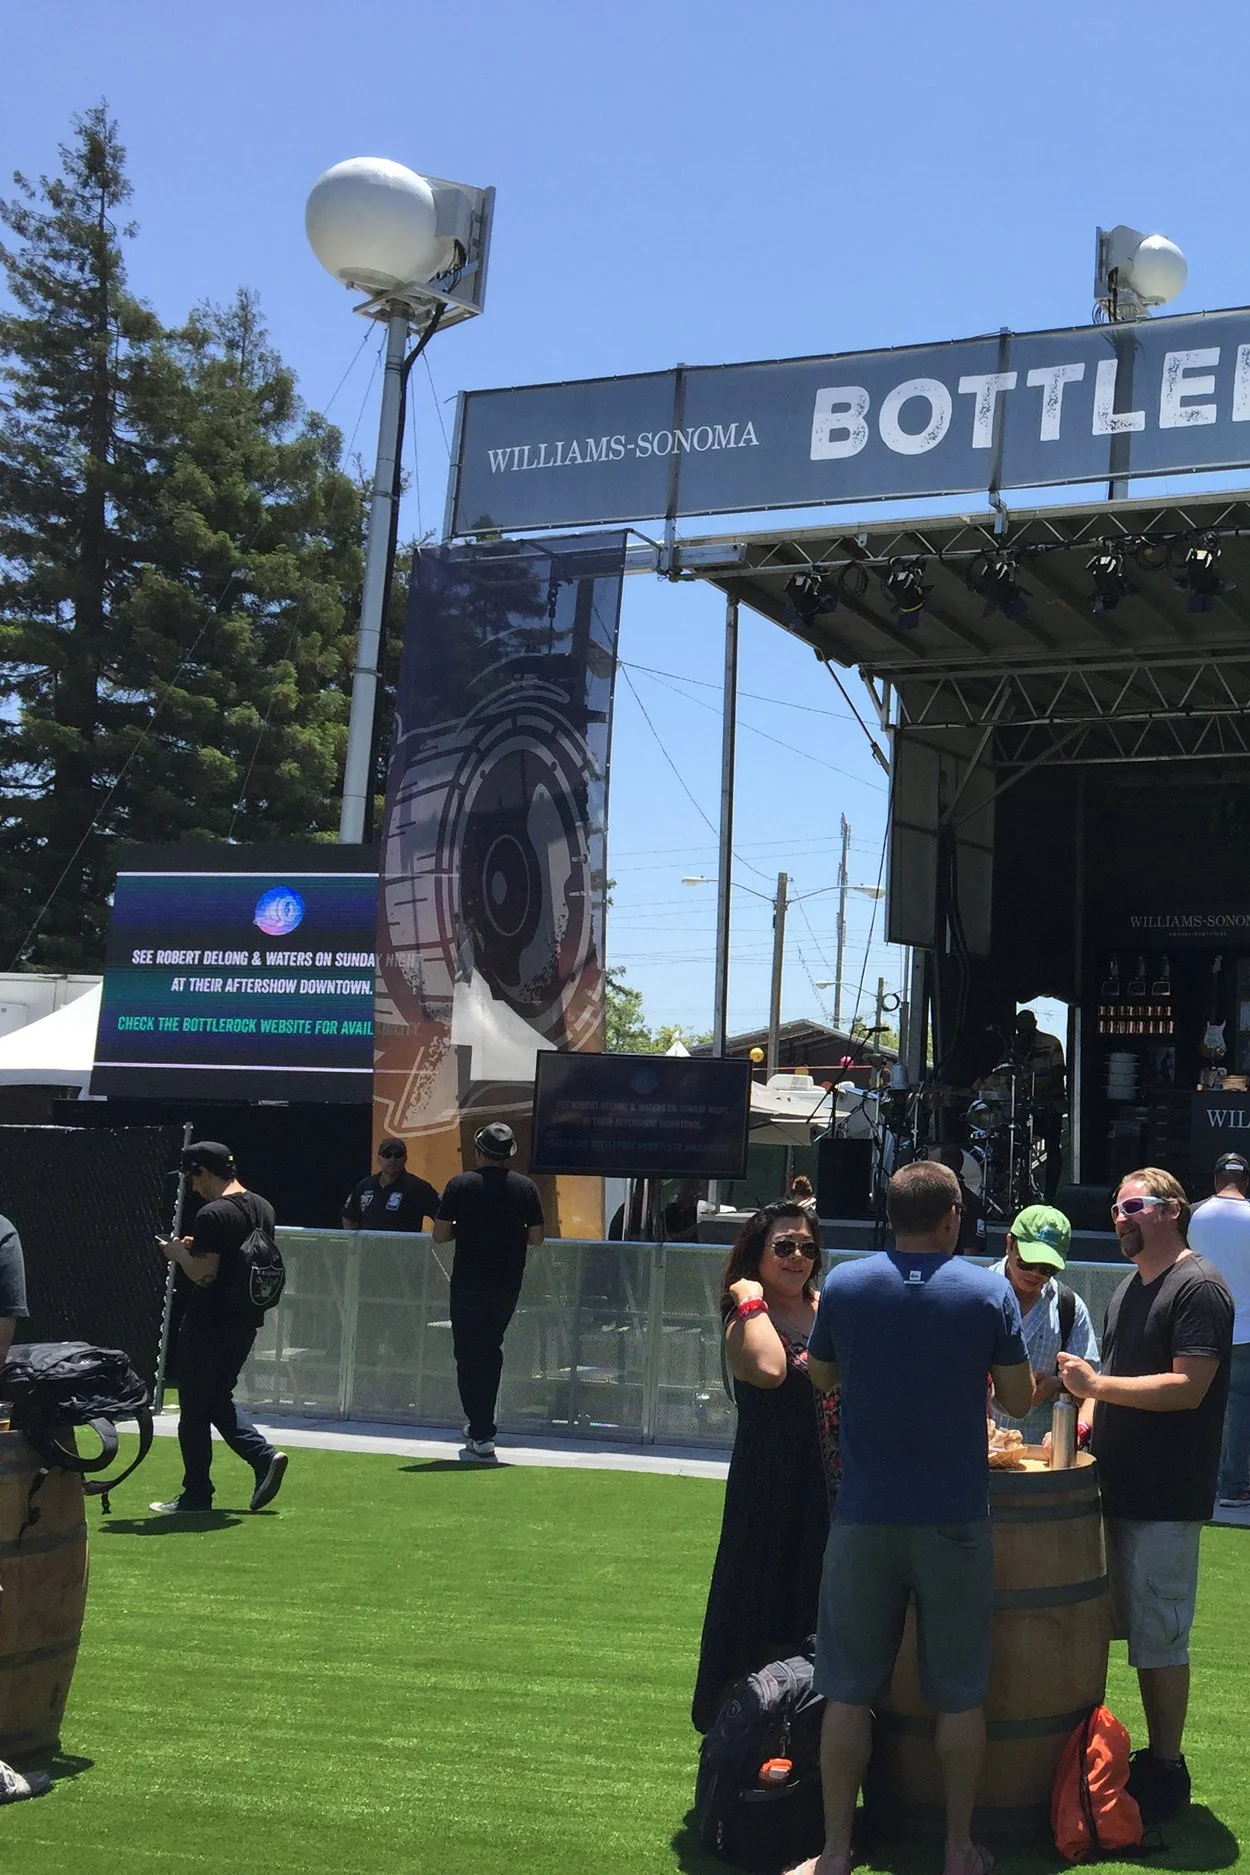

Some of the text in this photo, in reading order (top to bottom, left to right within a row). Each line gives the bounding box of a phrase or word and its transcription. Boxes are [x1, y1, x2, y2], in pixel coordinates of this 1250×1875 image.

[487, 421, 760, 473] WILLIAMS-SONOMA
[132, 949, 154, 964] SEE
[156, 950, 201, 965] ROBERT
[203, 950, 248, 966] DELONG
[251, 951, 262, 966] &
[266, 951, 313, 967] WATERS
[315, 952, 332, 967] ON
[171, 978, 373, 995] AT THEIR AFTERSHOW DOWNTOWN.
[118, 1016, 154, 1031] CHECK
[158, 1017, 180, 1031] THE
[183, 1017, 257, 1033] BOTTLEROCK
[260, 1019, 312, 1034] WEBSITE
[315, 1020, 337, 1035] FOR
